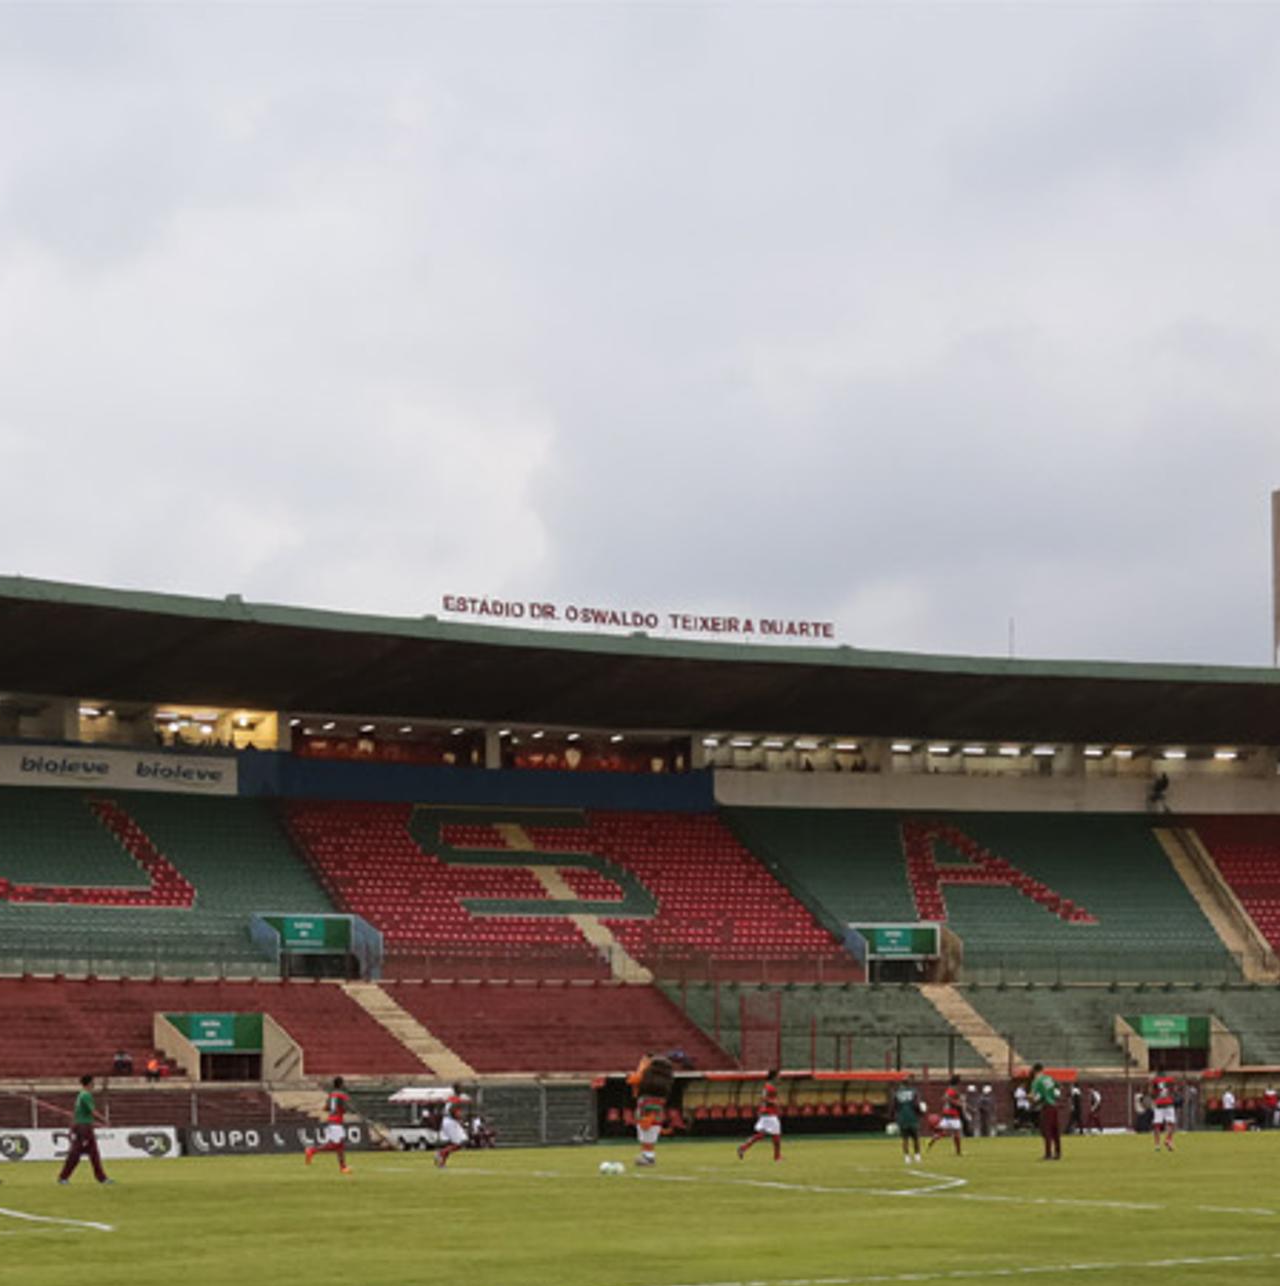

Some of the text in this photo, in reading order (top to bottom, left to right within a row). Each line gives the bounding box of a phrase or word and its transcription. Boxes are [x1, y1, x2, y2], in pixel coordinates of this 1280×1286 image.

[529, 602, 560, 620] DR.
[564, 605, 658, 629] OSWALDO
[669, 613, 755, 634] TEIXEIRA
[759, 618, 835, 638] DUARTE
[21, 755, 110, 775] bioleve
[135, 761, 223, 781] bioleve
[193, 1130, 260, 1151] LUPO
[297, 1127, 362, 1145] LUO
